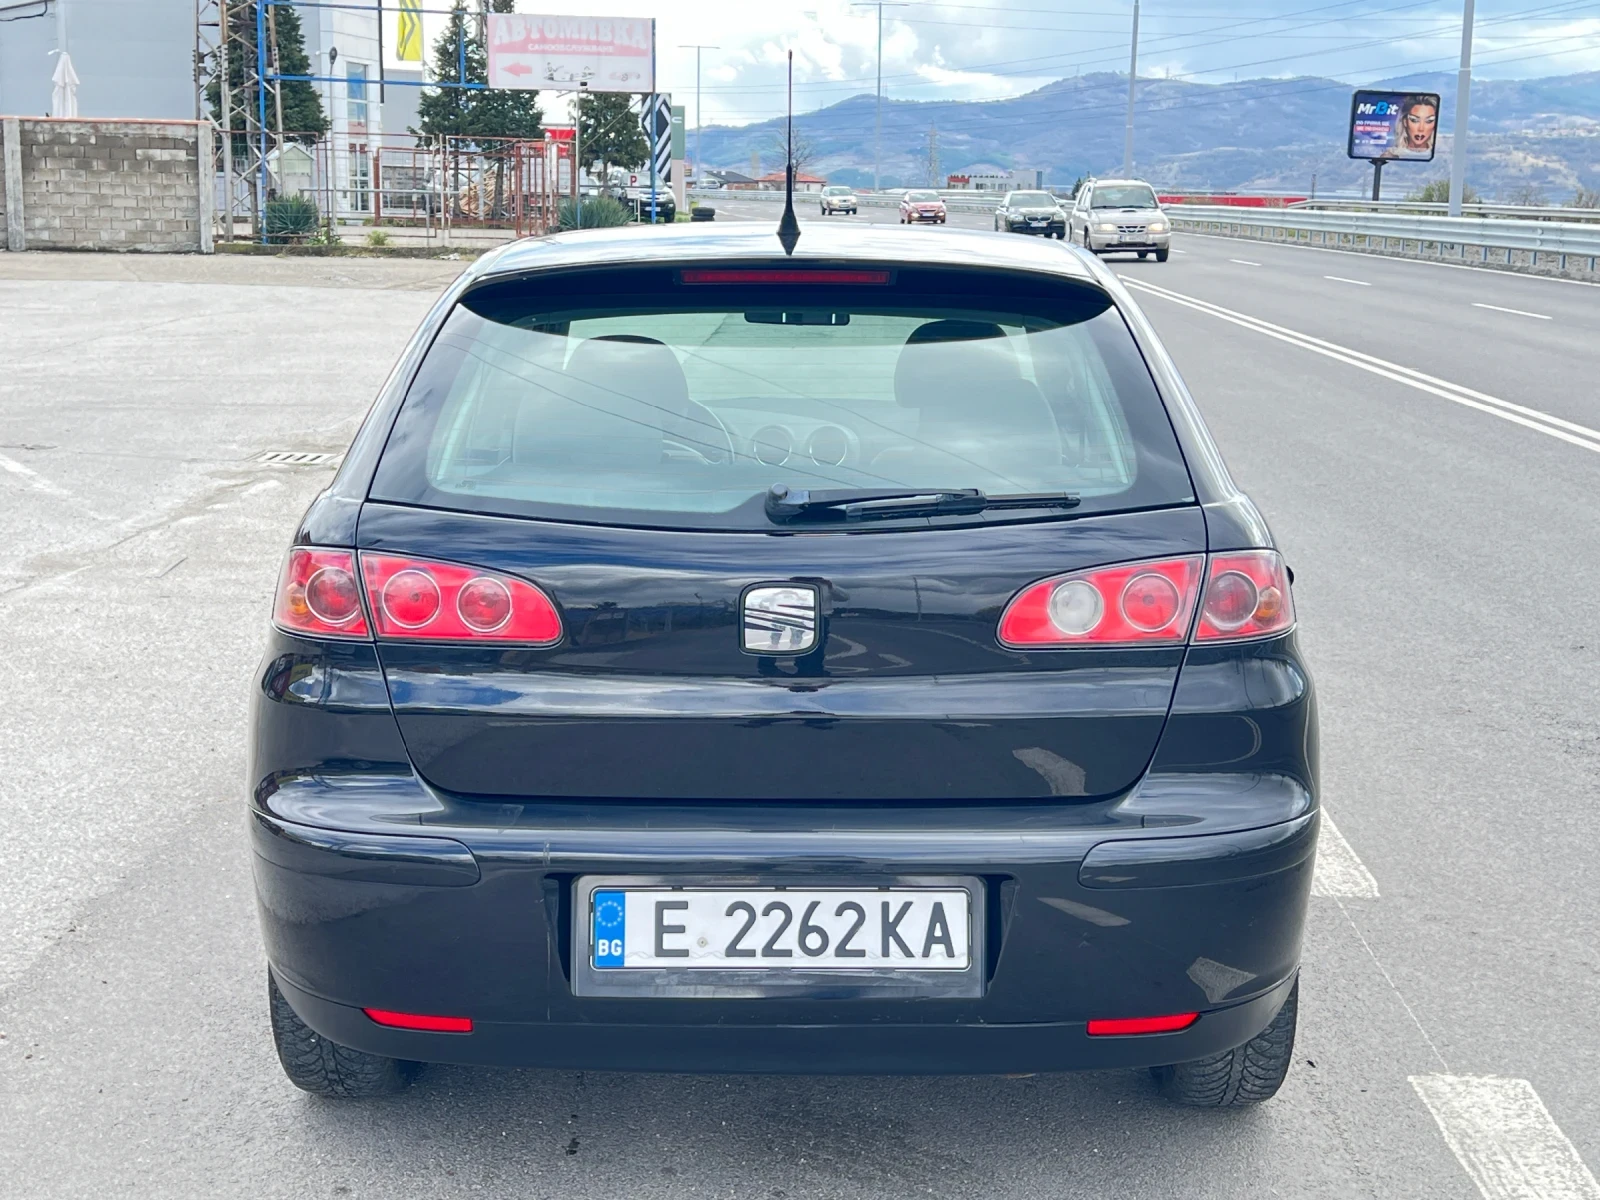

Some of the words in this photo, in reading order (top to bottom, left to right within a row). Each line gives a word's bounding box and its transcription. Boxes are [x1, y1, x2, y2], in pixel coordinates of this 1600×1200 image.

[493, 17, 648, 49] АВТОМИВКА
[1357, 101, 1399, 115] MrBit
[630, 175, 637, 186] P
[597, 939, 622, 957] BG
[654, 900, 690, 958] E
